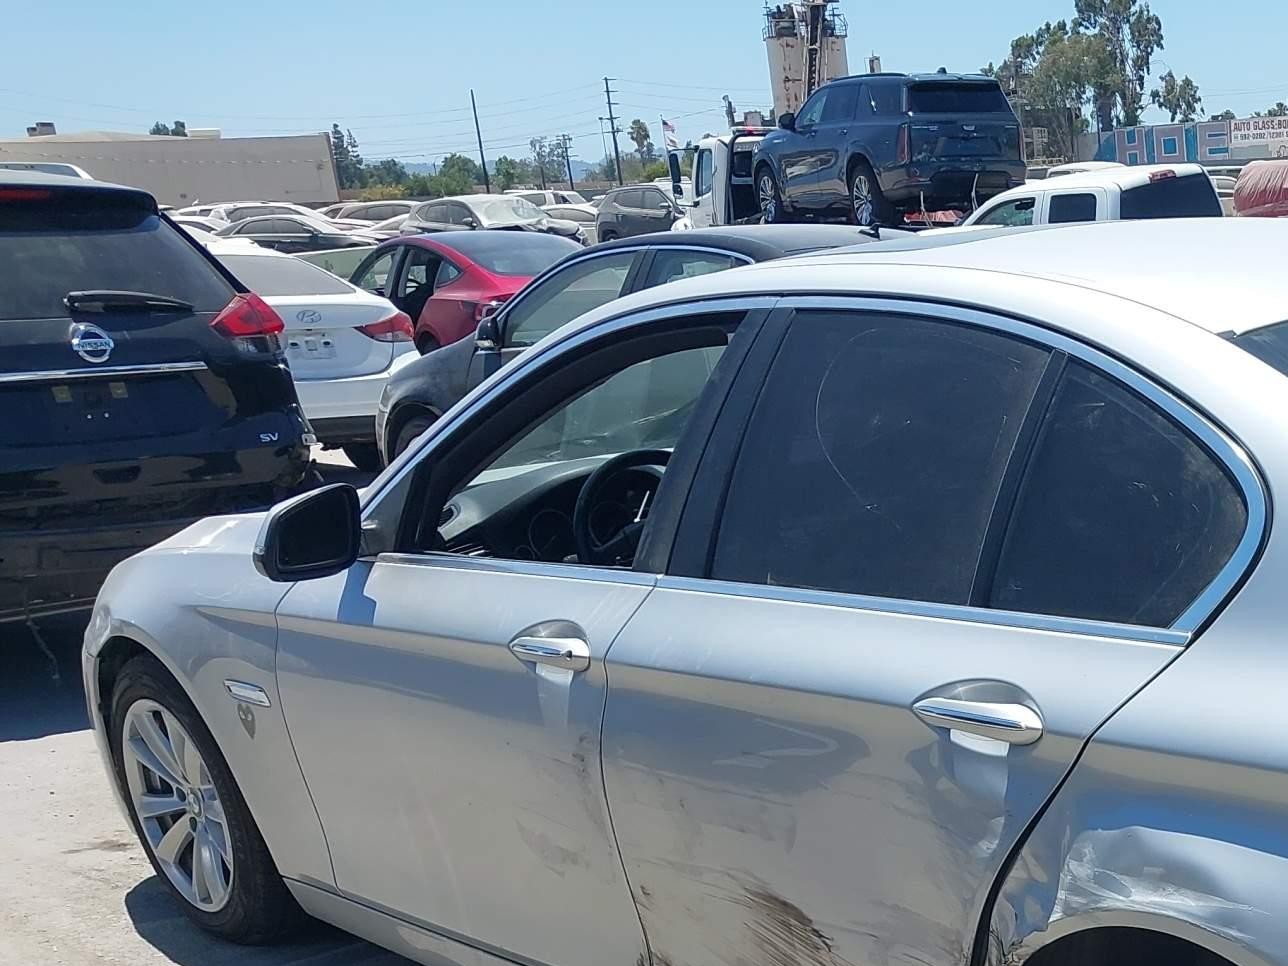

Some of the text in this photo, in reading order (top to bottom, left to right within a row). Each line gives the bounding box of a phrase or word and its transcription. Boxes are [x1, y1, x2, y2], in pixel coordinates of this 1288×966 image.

[1233, 121, 1251, 133] AUTO
[78, 339, 112, 350] NISSAN
[259, 432, 279, 443] SV
